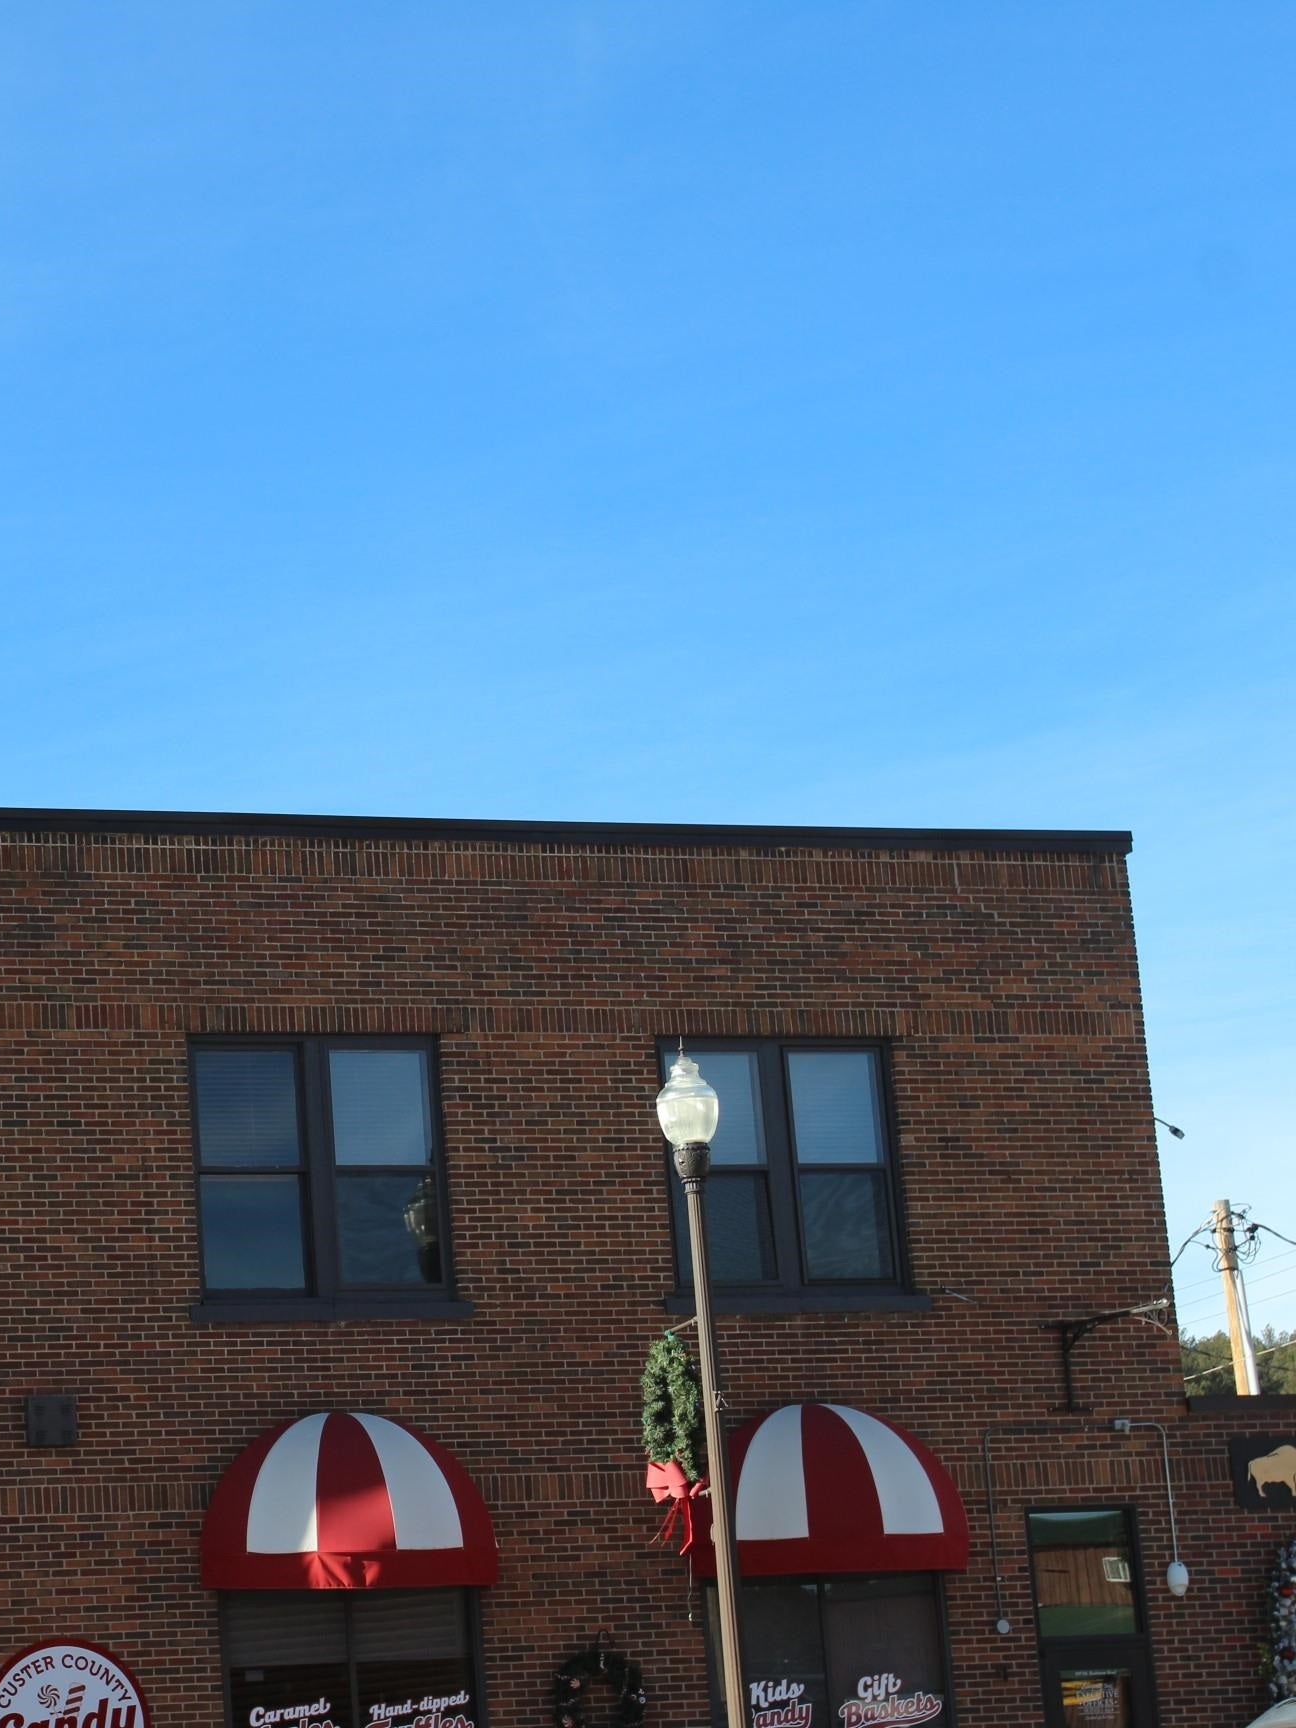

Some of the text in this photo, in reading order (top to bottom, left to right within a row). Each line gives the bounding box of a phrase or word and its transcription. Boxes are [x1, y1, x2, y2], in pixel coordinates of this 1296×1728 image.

[61, 1653, 133, 1703] COUNTY
[749, 1679, 805, 1708] Kids
[857, 1672, 902, 1702] Gift
[249, 1697, 331, 1728] Caramel
[369, 1690, 470, 1721] Hand-dipped
[752, 1698, 812, 1728] andy
[838, 1691, 943, 1728] Baskets
